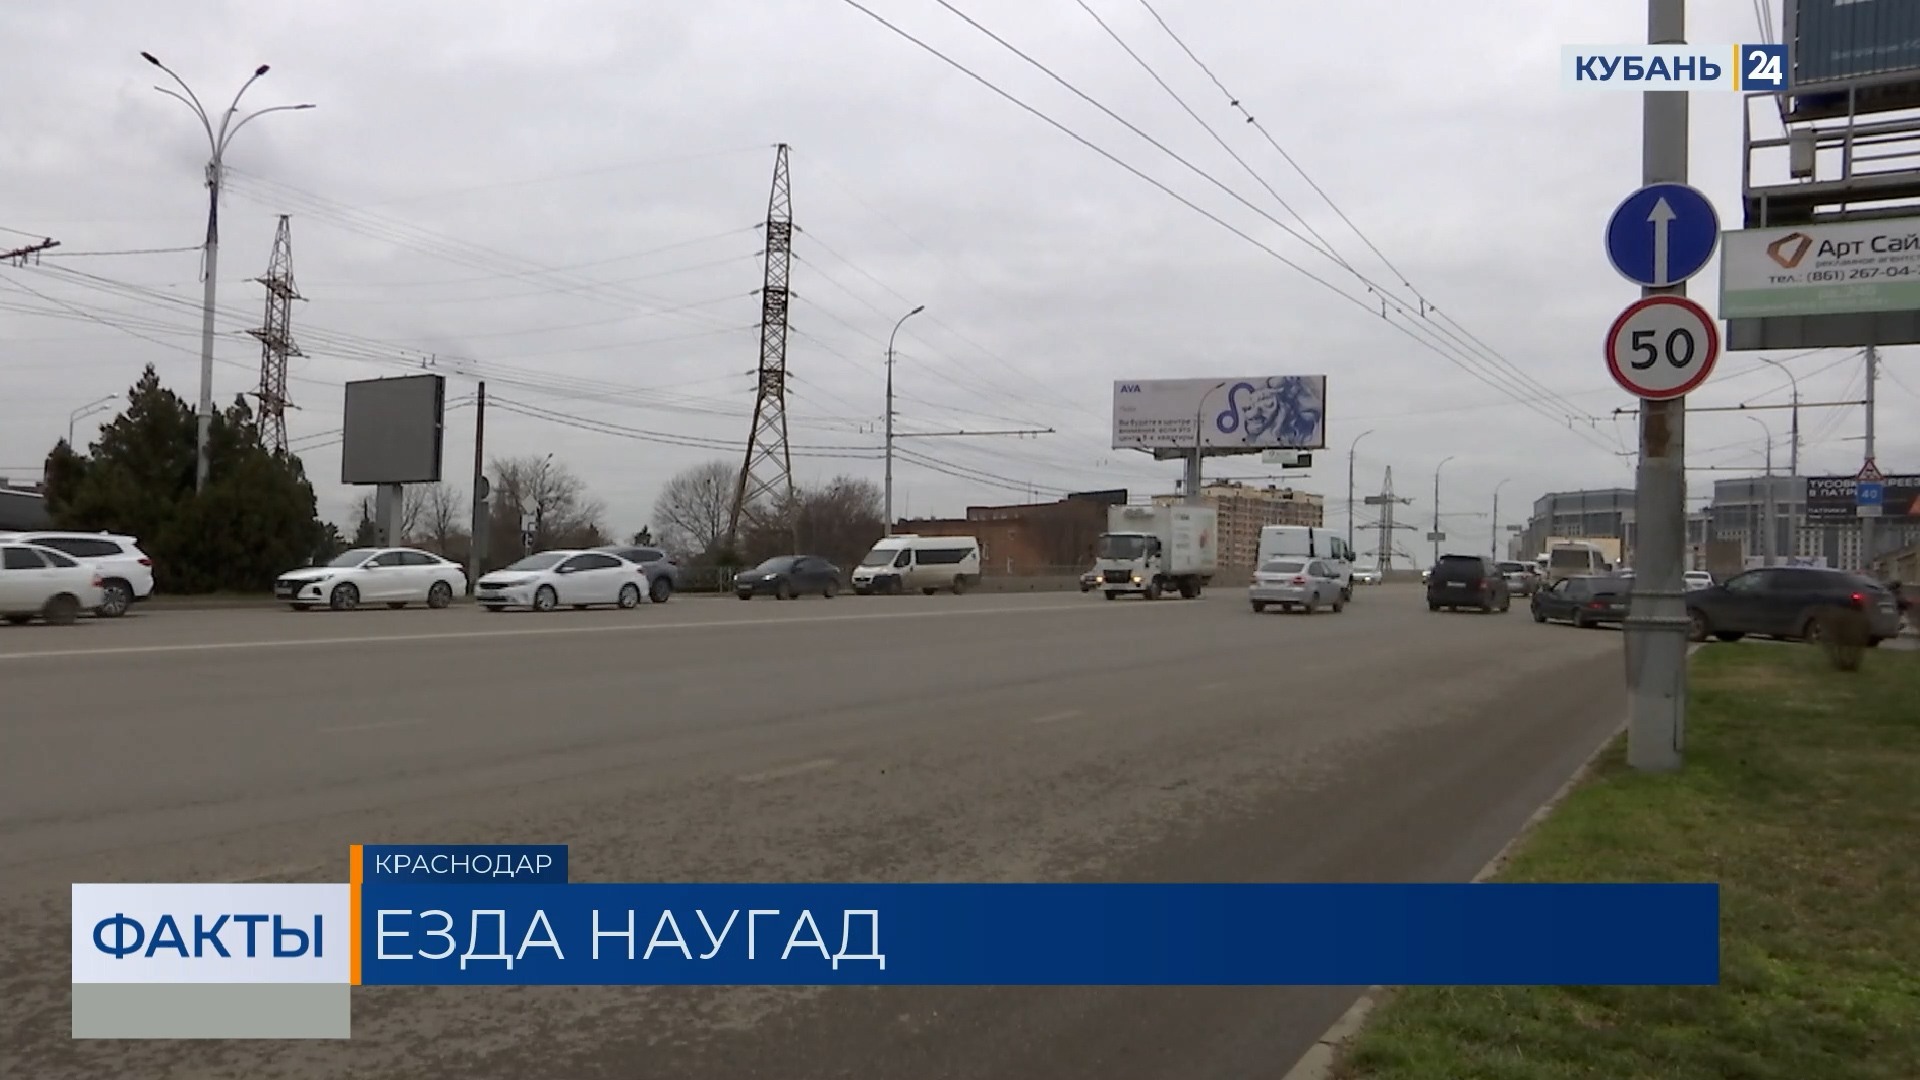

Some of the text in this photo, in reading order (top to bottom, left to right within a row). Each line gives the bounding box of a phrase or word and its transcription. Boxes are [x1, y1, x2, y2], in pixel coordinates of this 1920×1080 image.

[1817, 233, 1920, 259] Арт Сай
[1807, 270, 1845, 283] (861)
[1632, 327, 1695, 370] 50
[1120, 384, 1141, 393] AVA
[1810, 479, 1858, 488] ТУСОВК
[1861, 489, 1878, 499] 40
